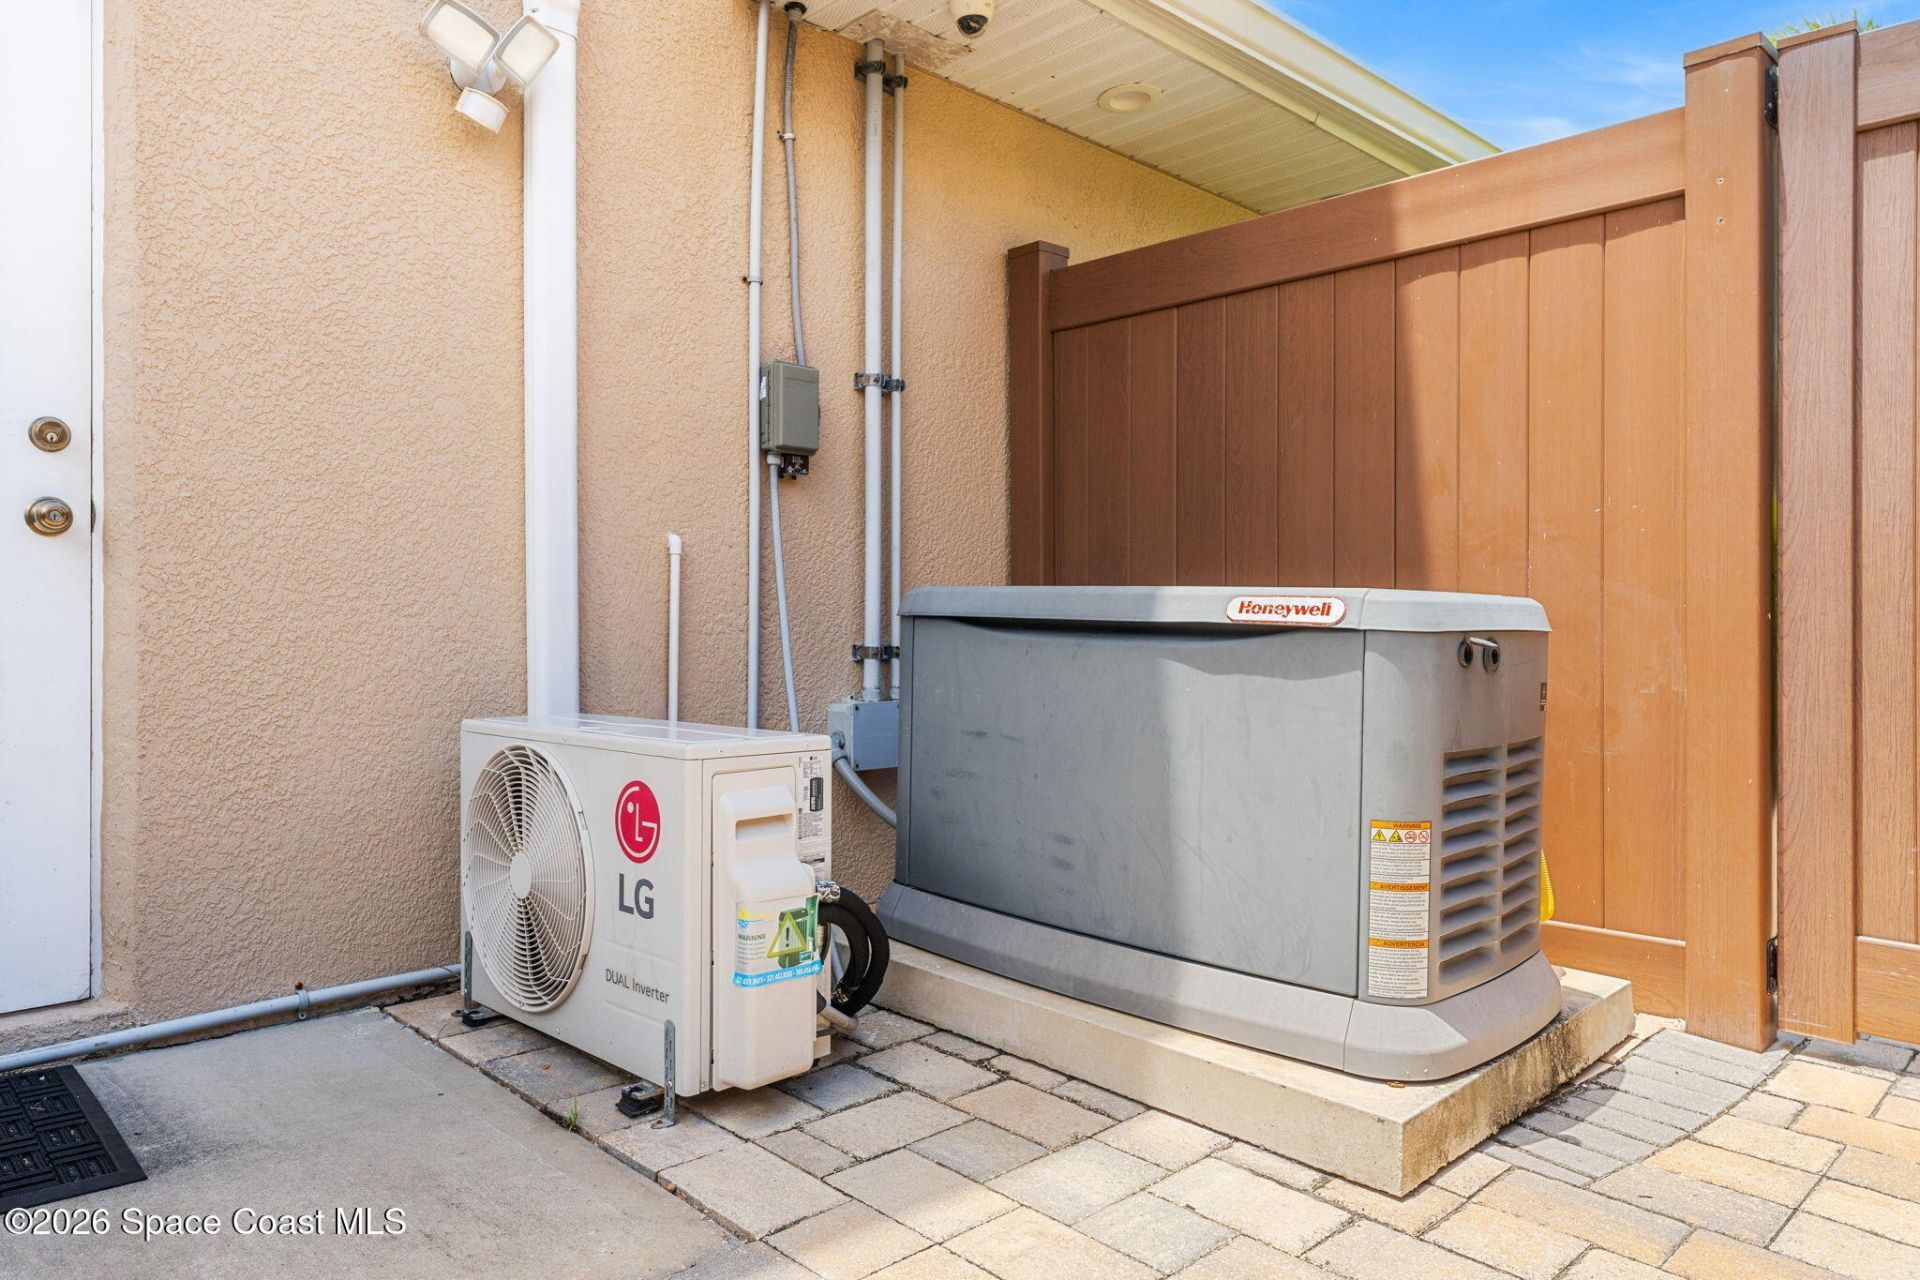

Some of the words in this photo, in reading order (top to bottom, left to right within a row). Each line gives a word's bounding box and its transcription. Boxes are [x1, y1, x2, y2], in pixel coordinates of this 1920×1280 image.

[1238, 600, 1333, 619] Honeywell
[618, 872, 655, 920] LG
[738, 933, 766, 942] WARNING
[605, 967, 630, 990] DUAL
[632, 977, 670, 1005] Inverter
